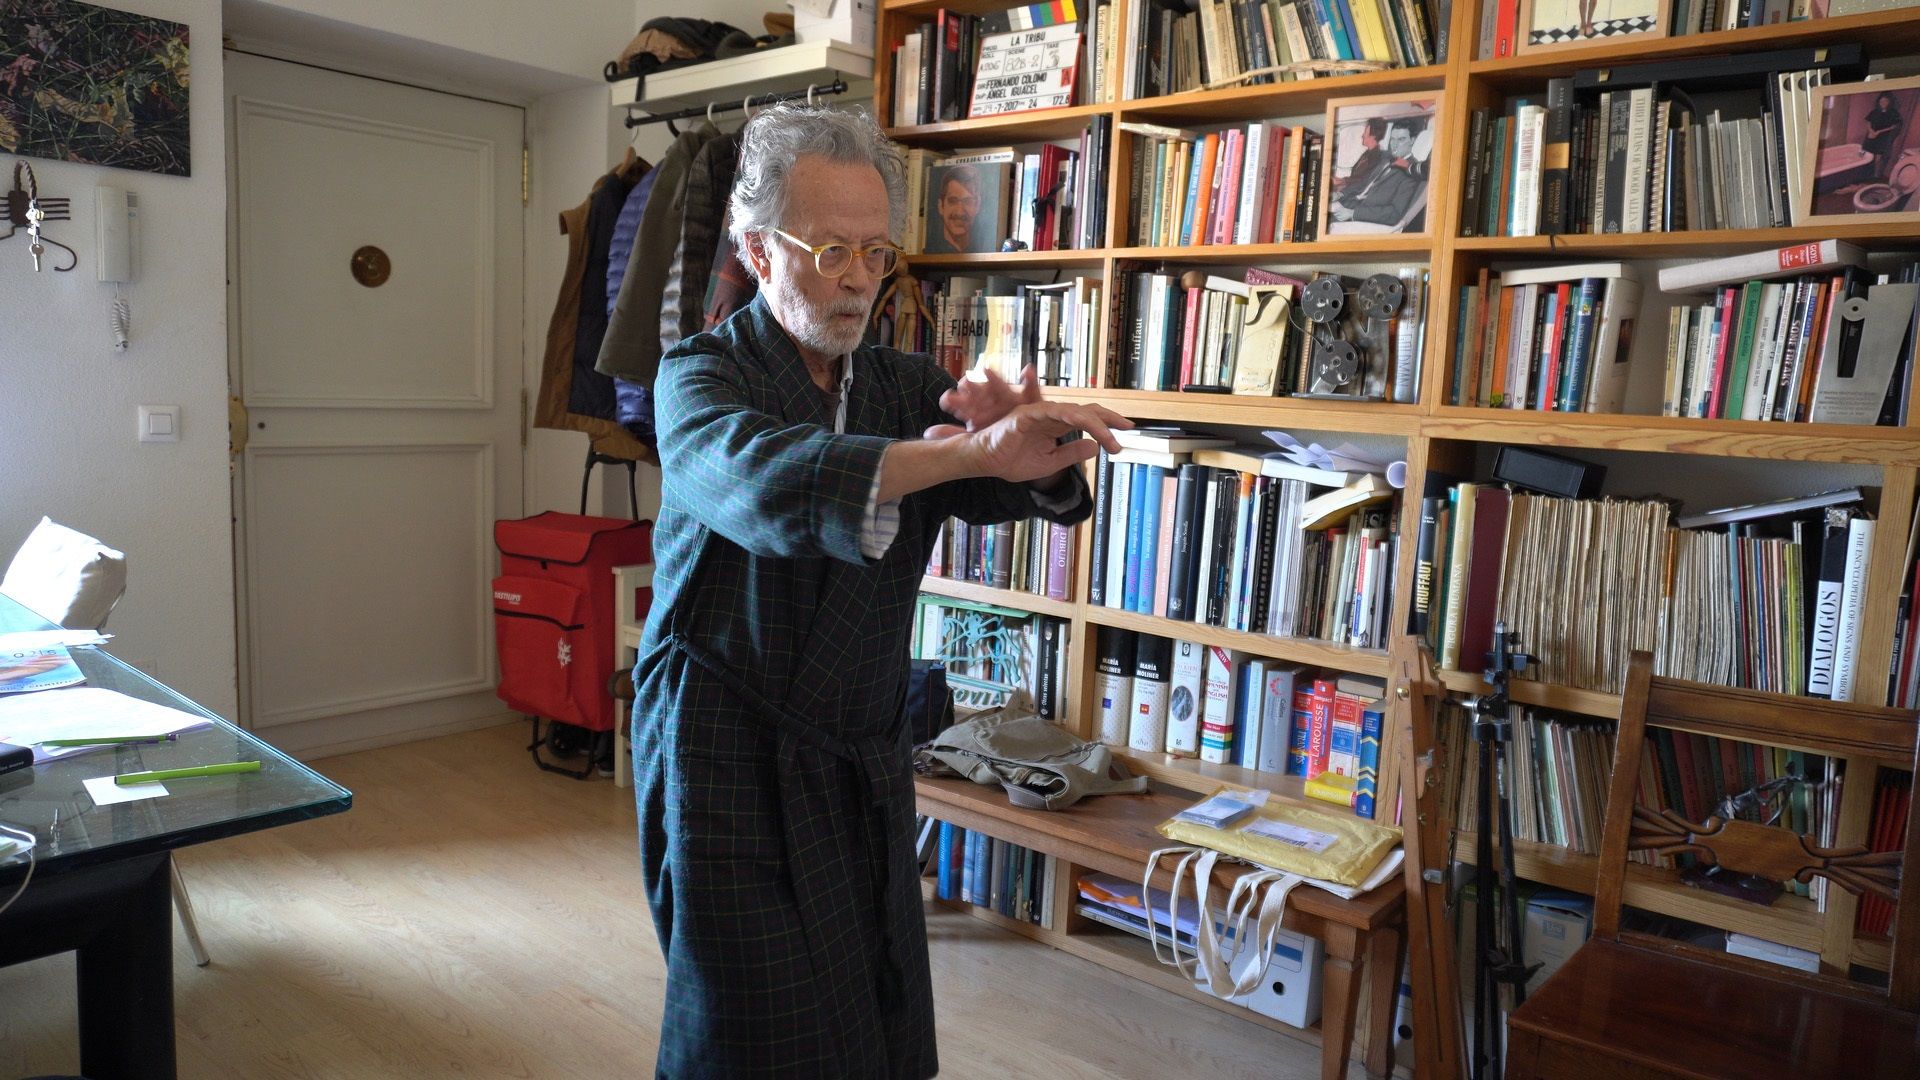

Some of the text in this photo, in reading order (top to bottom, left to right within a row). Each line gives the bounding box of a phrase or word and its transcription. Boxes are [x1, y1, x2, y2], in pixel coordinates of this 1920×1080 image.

[1011, 32, 1046, 46] LA TRIBU
[987, 76, 1020, 88] FERNANDO
[1021, 72, 1047, 84] COLOMO
[1011, 84, 1038, 97] IGUACEL
[1028, 99, 1038, 108] 24
[1306, 195, 1314, 222] screen
[1809, 244, 1819, 265] GOYA
[1130, 318, 1143, 363] Truffaut
[1787, 319, 1801, 346] SOME
[1780, 348, 1796, 387] FREAKS
[1097, 454, 1108, 525] EL BOSQUE ANIMADO
[1058, 532, 1068, 568] DIBUJO
[1416, 559, 1432, 609] TRUFFAUT
[1446, 563, 1463, 650] FIGURA HUMANA
[1838, 531, 1866, 700] THE ENCYCLOPEDIA OF SIGNS AND SYMBOLS
[1812, 591, 1838, 686] DIALOGOS
[1102, 657, 1119, 667] MARÍA
[1139, 662, 1157, 672] MARÍA
[1217, 650, 1229, 663] NEW
[1100, 664, 1122, 675] MOLINER
[1136, 669, 1160, 680] MOLINER
[953, 686, 1006, 706] OVIA
[1313, 703, 1325, 758] LAROUSSE
